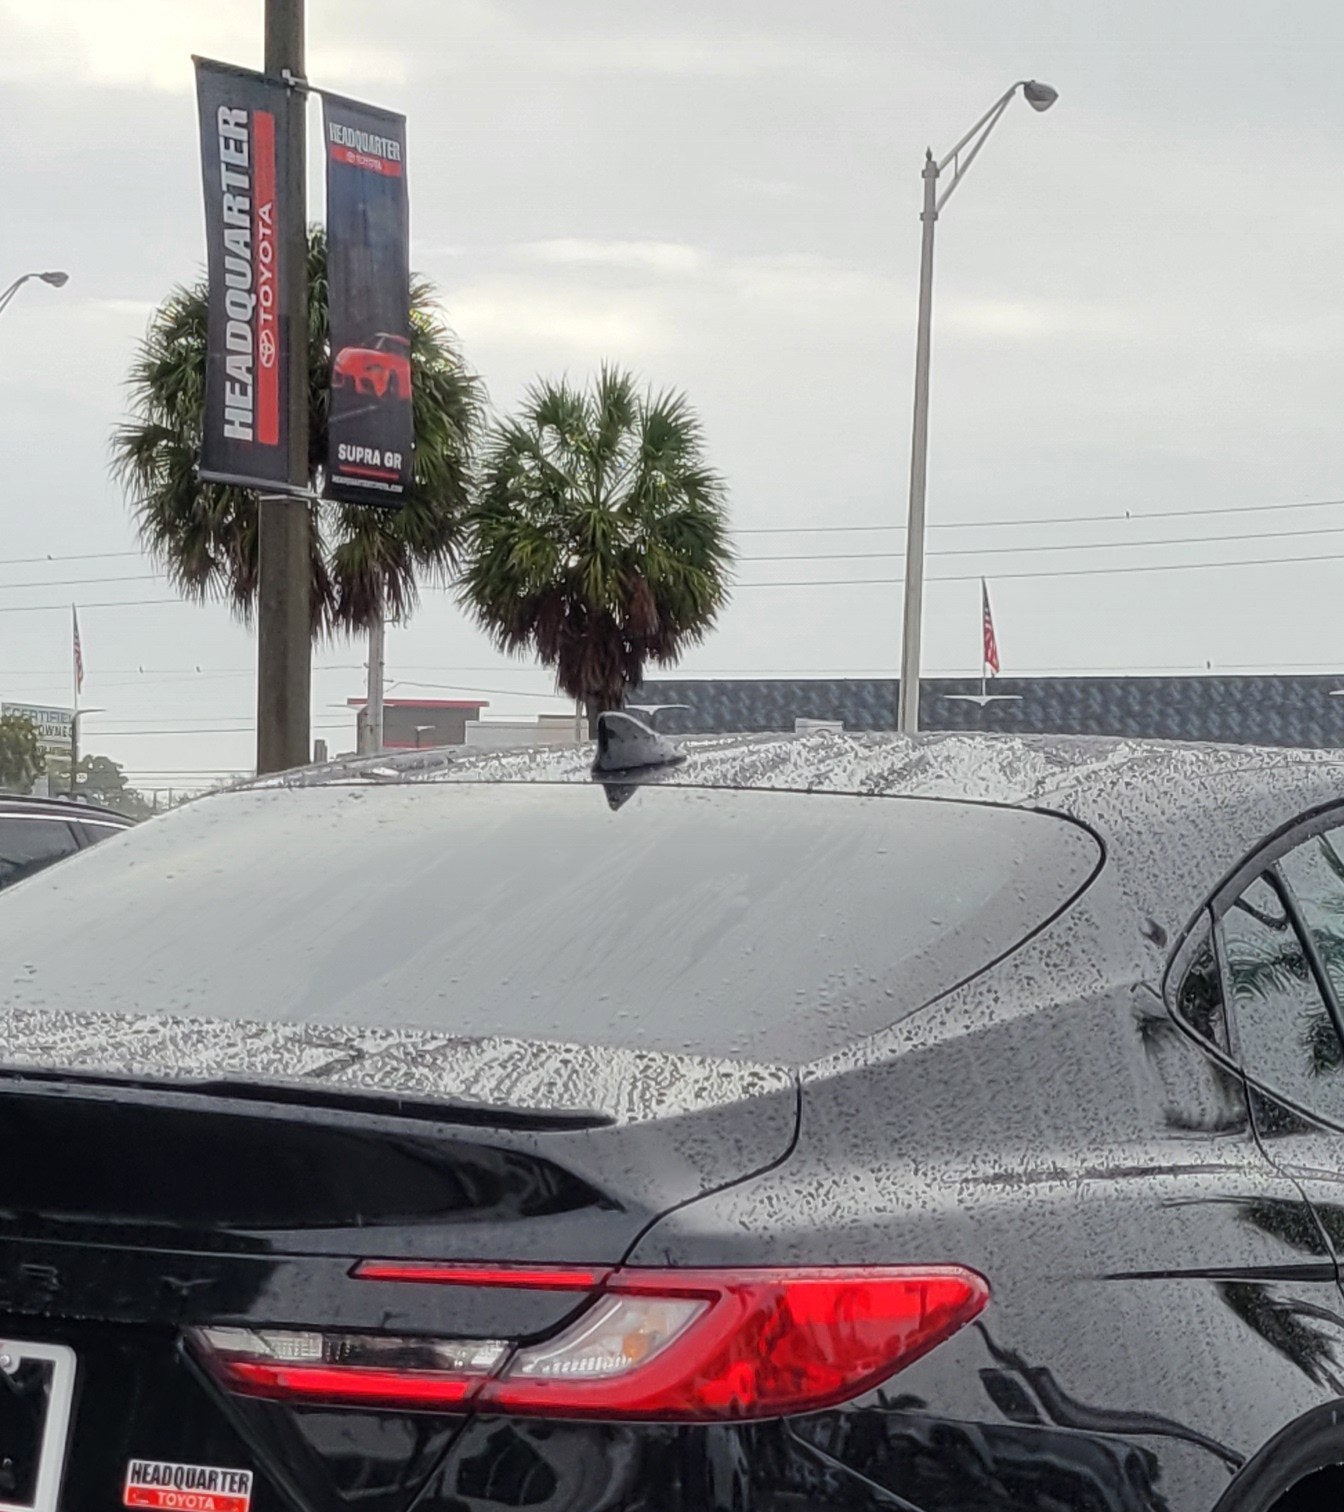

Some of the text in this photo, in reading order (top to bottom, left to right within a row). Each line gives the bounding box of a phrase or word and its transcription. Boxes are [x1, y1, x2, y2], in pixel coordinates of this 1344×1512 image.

[329, 122, 401, 162] HEADQUARTER
[218, 105, 257, 442] HEADQUARTER
[258, 202, 274, 326] TOYOTA
[338, 443, 402, 470] SUPRA GR
[130, 1462, 250, 1494] HEADQUARTER
[157, 1492, 215, 1510] TOYOTA
